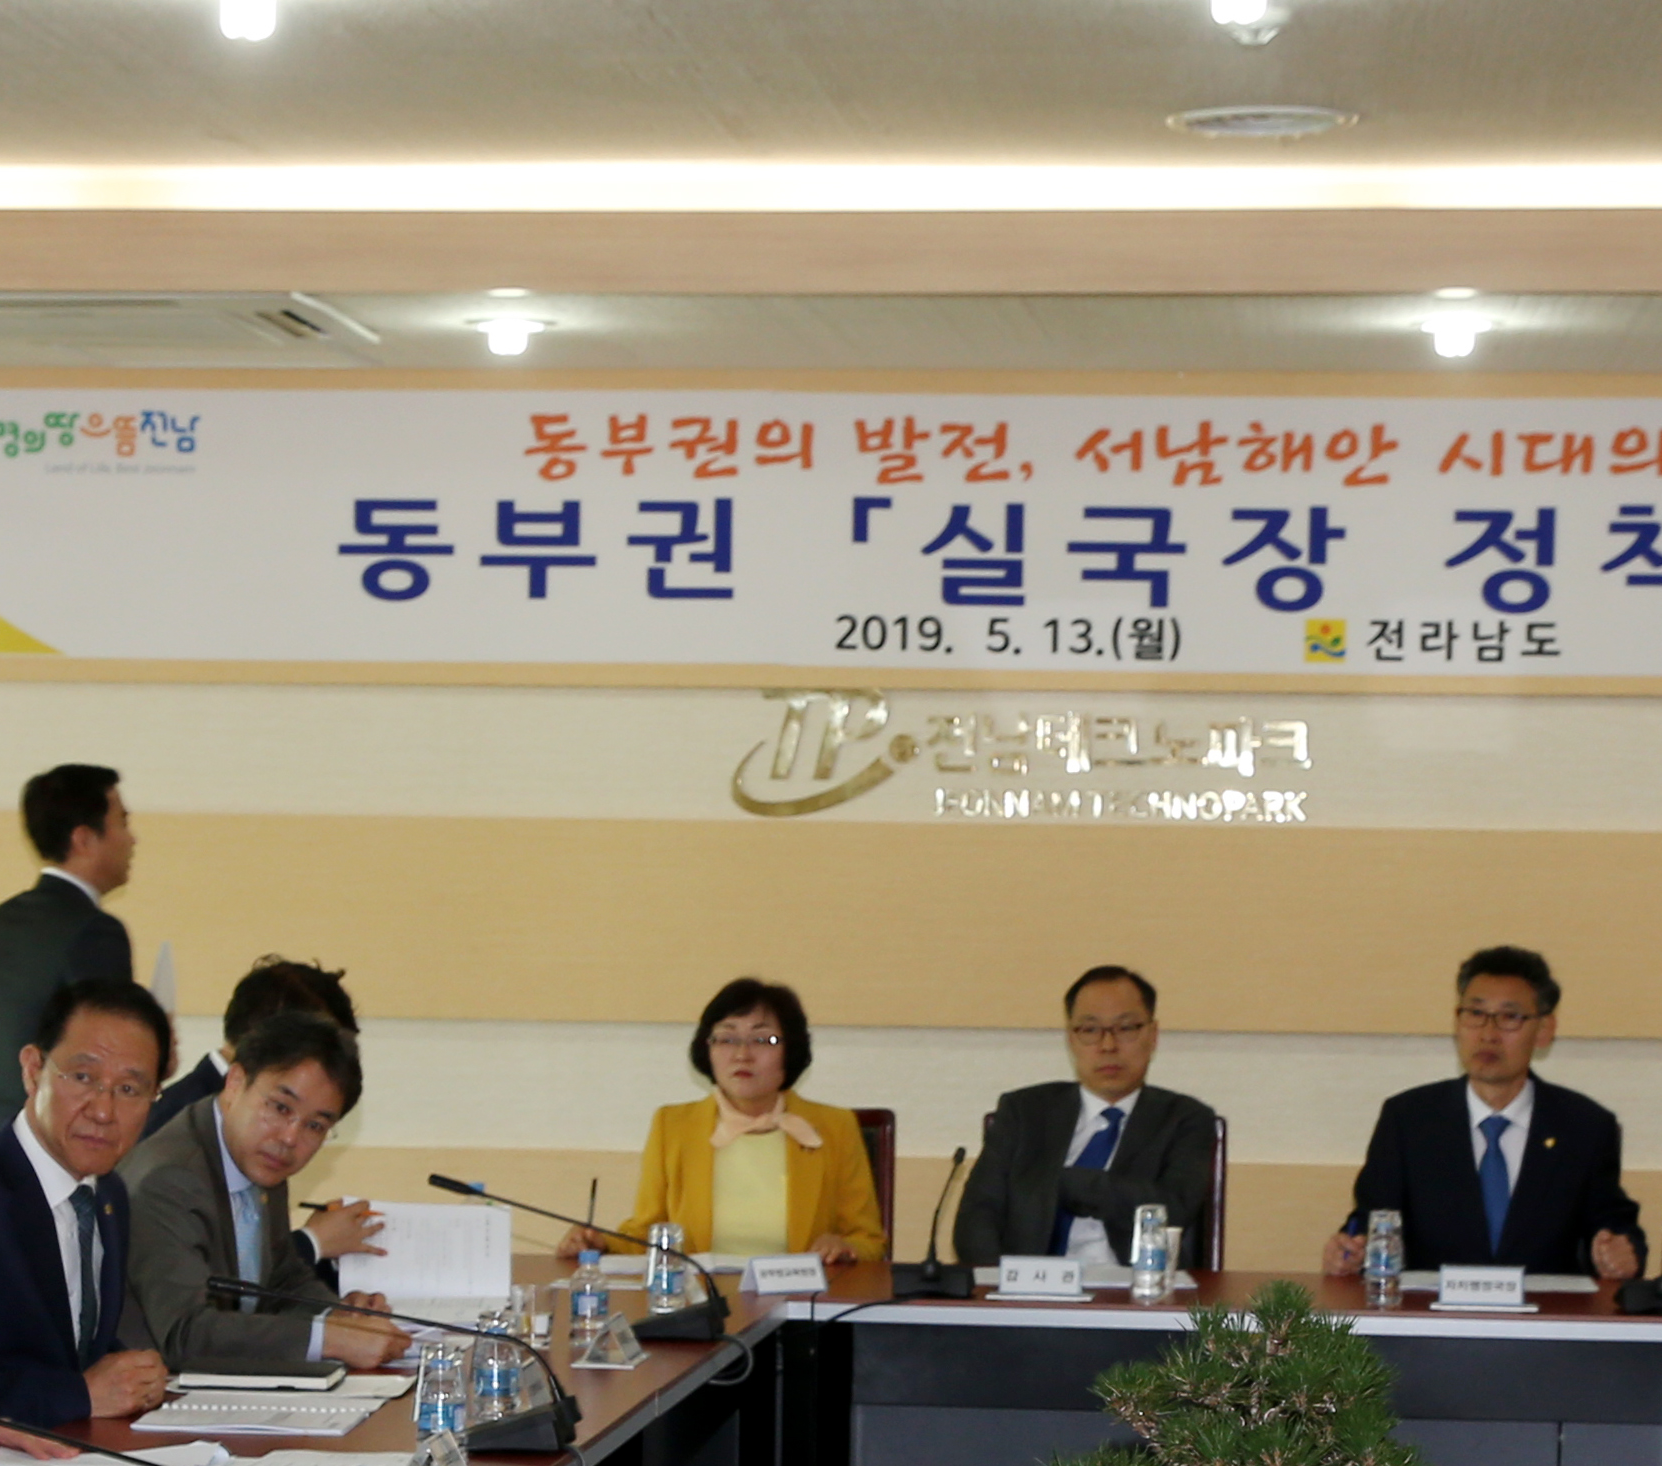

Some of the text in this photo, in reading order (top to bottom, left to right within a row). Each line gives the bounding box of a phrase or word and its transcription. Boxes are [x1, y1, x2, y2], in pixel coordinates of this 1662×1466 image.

[524, 412, 815, 482] 동부권의
[854, 415, 1035, 486] 발전,
[1074, 419, 1399, 488] 서남해안
[338, 498, 734, 600] 동부권
[835, 614, 1182, 662] 2019. 5. 13.(월)
[1367, 619, 1562, 663] 전라남도
